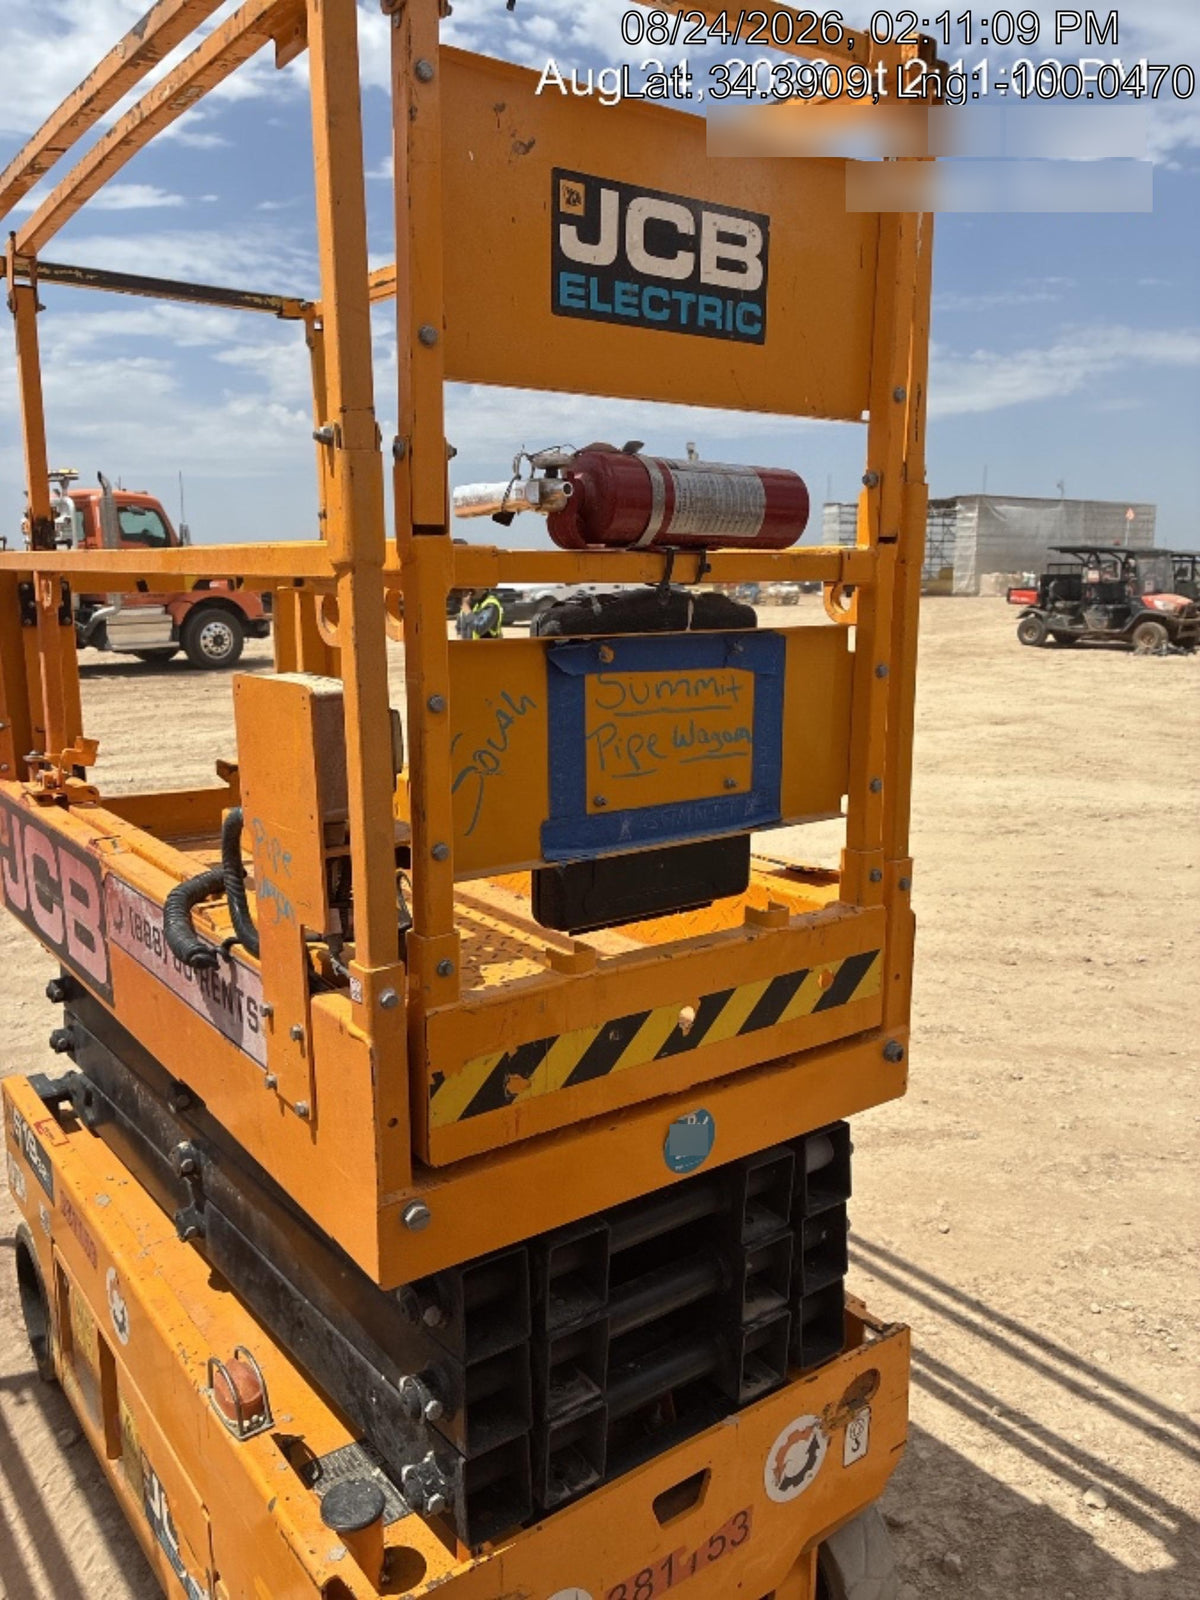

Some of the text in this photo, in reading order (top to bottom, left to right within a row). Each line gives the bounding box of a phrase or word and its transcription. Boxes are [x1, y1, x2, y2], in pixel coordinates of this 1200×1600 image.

[559, 188, 764, 291] JCB
[559, 271, 762, 335] ELECTRIC
[595, 673, 744, 710] Summit
[585, 722, 668, 771] Pipe
[2, 813, 108, 985] JCB
